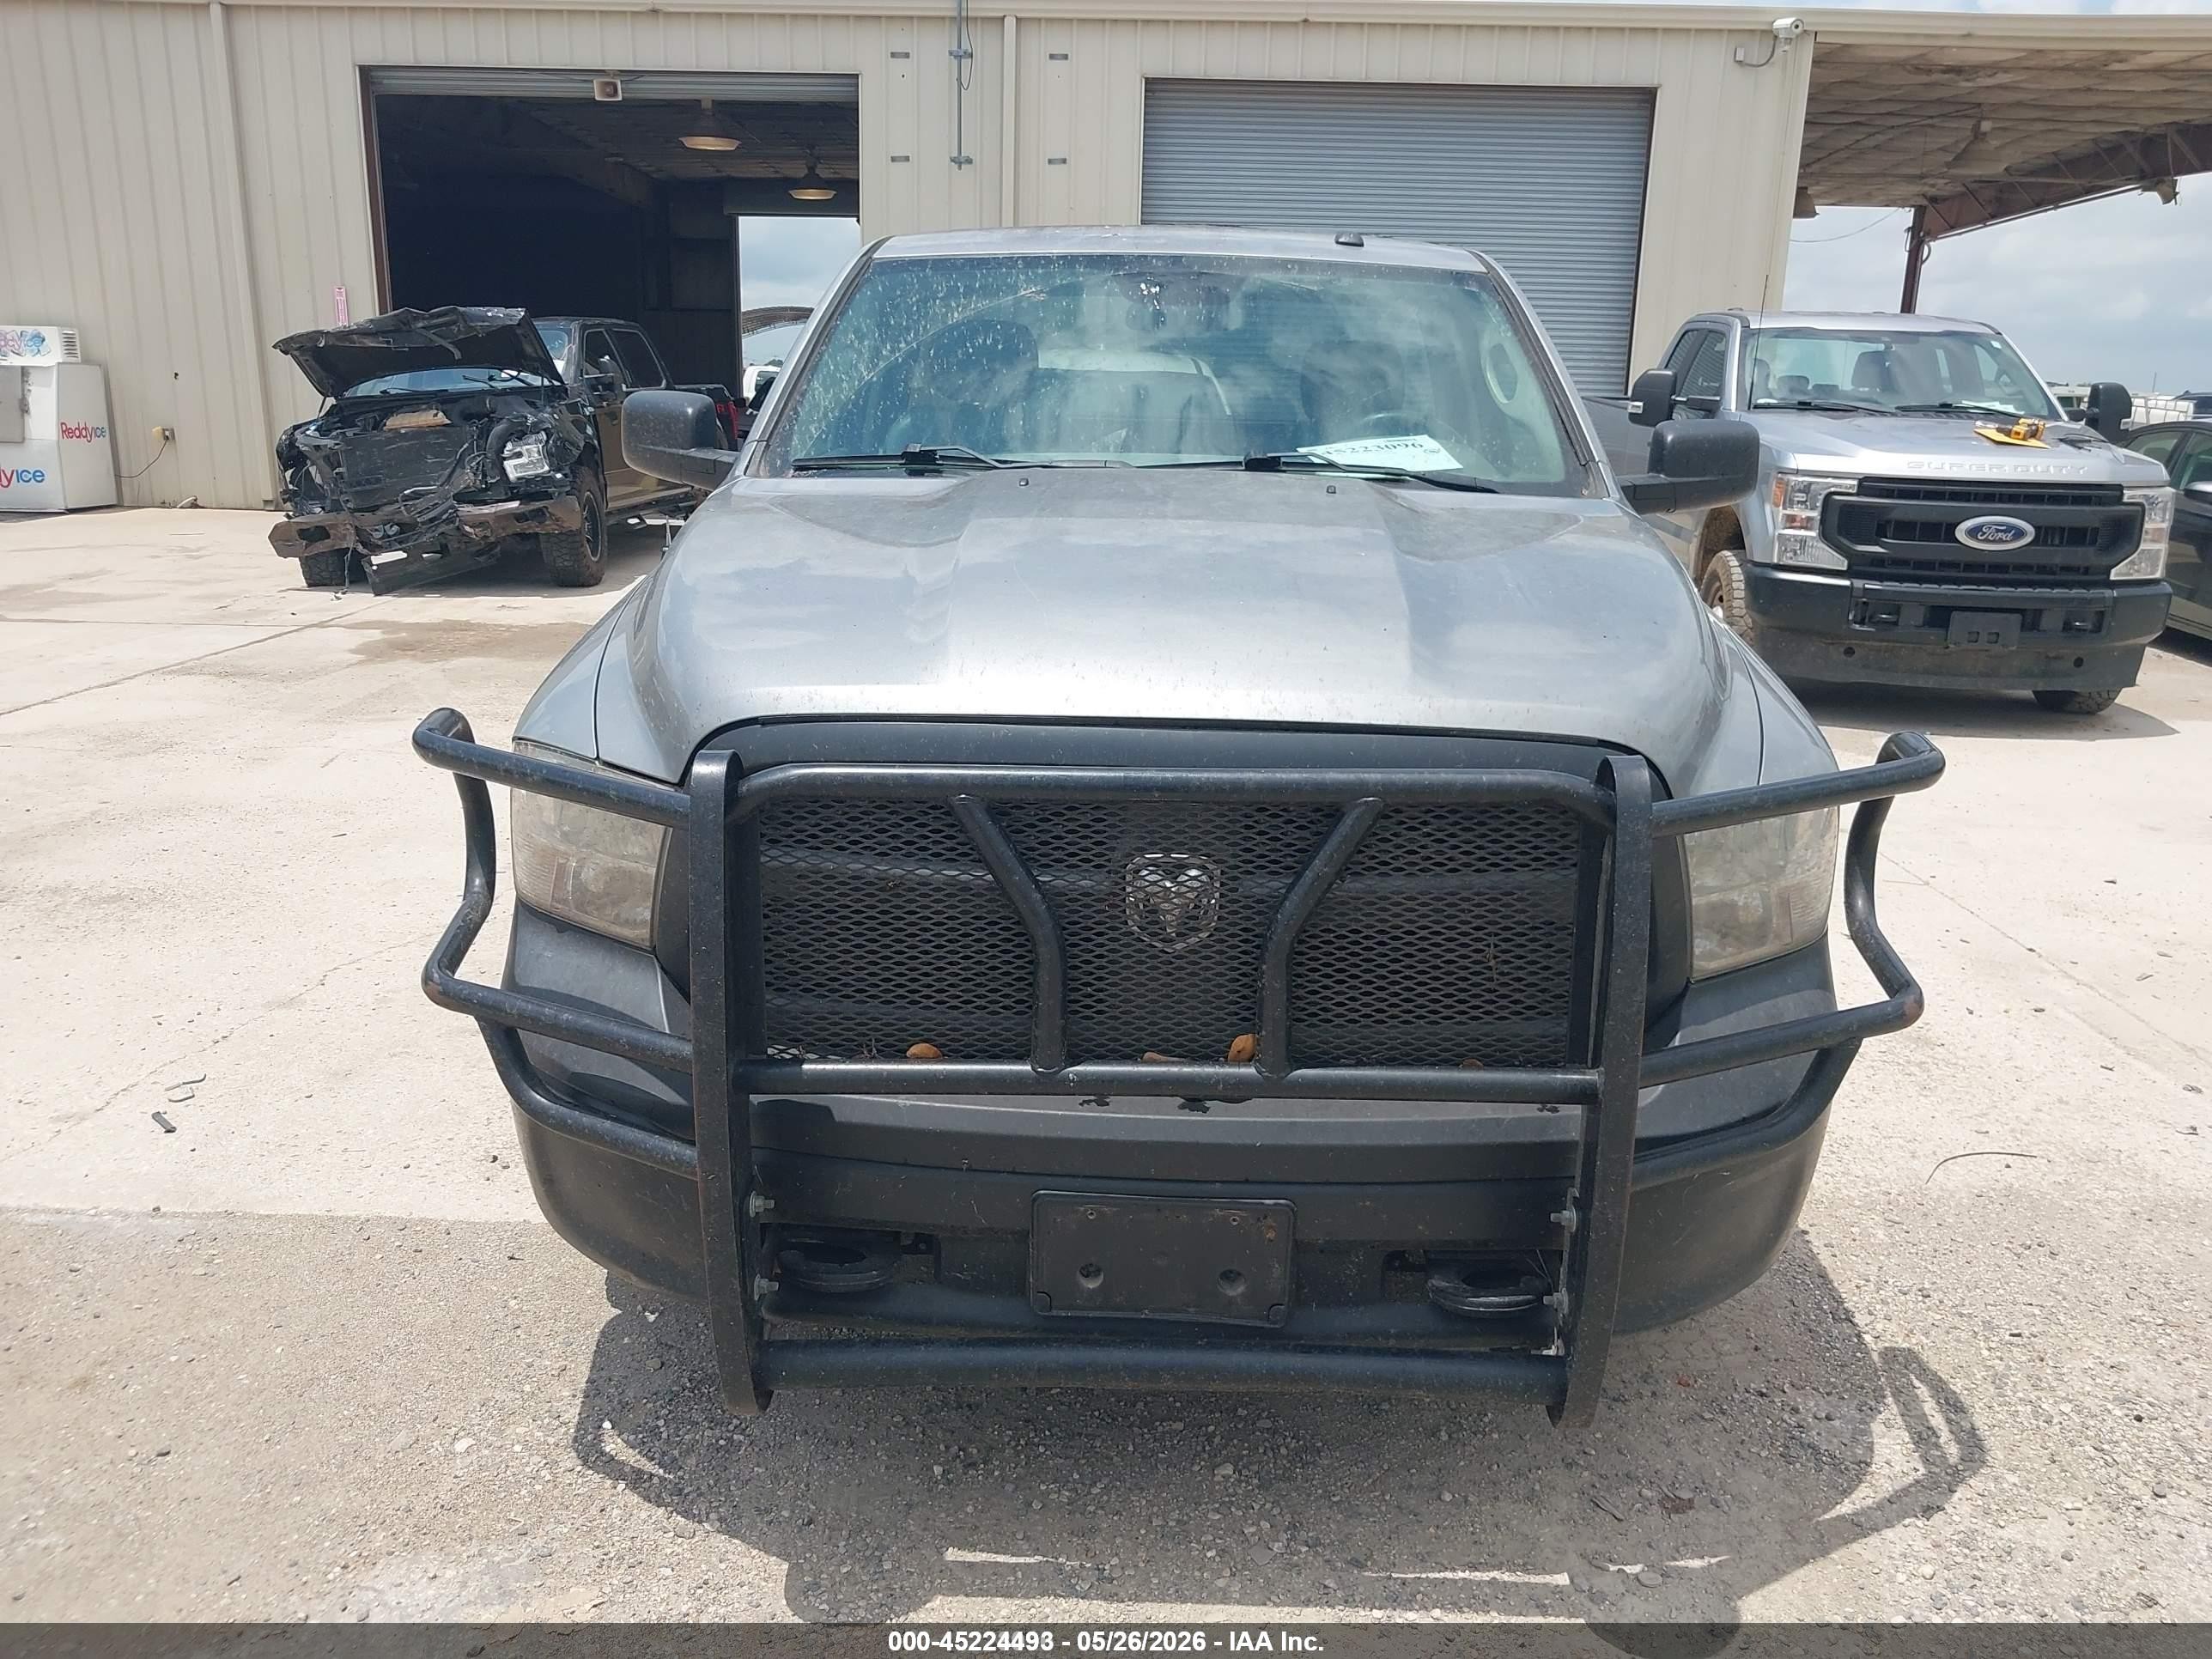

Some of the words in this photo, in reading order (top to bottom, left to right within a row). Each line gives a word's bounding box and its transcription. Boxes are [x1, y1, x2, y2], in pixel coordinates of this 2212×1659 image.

[1906, 460, 2008, 473] SUPER
[2013, 464, 2088, 475] DUTY
[0, 468, 46, 488] yice
[1977, 524, 2016, 543] Ford
